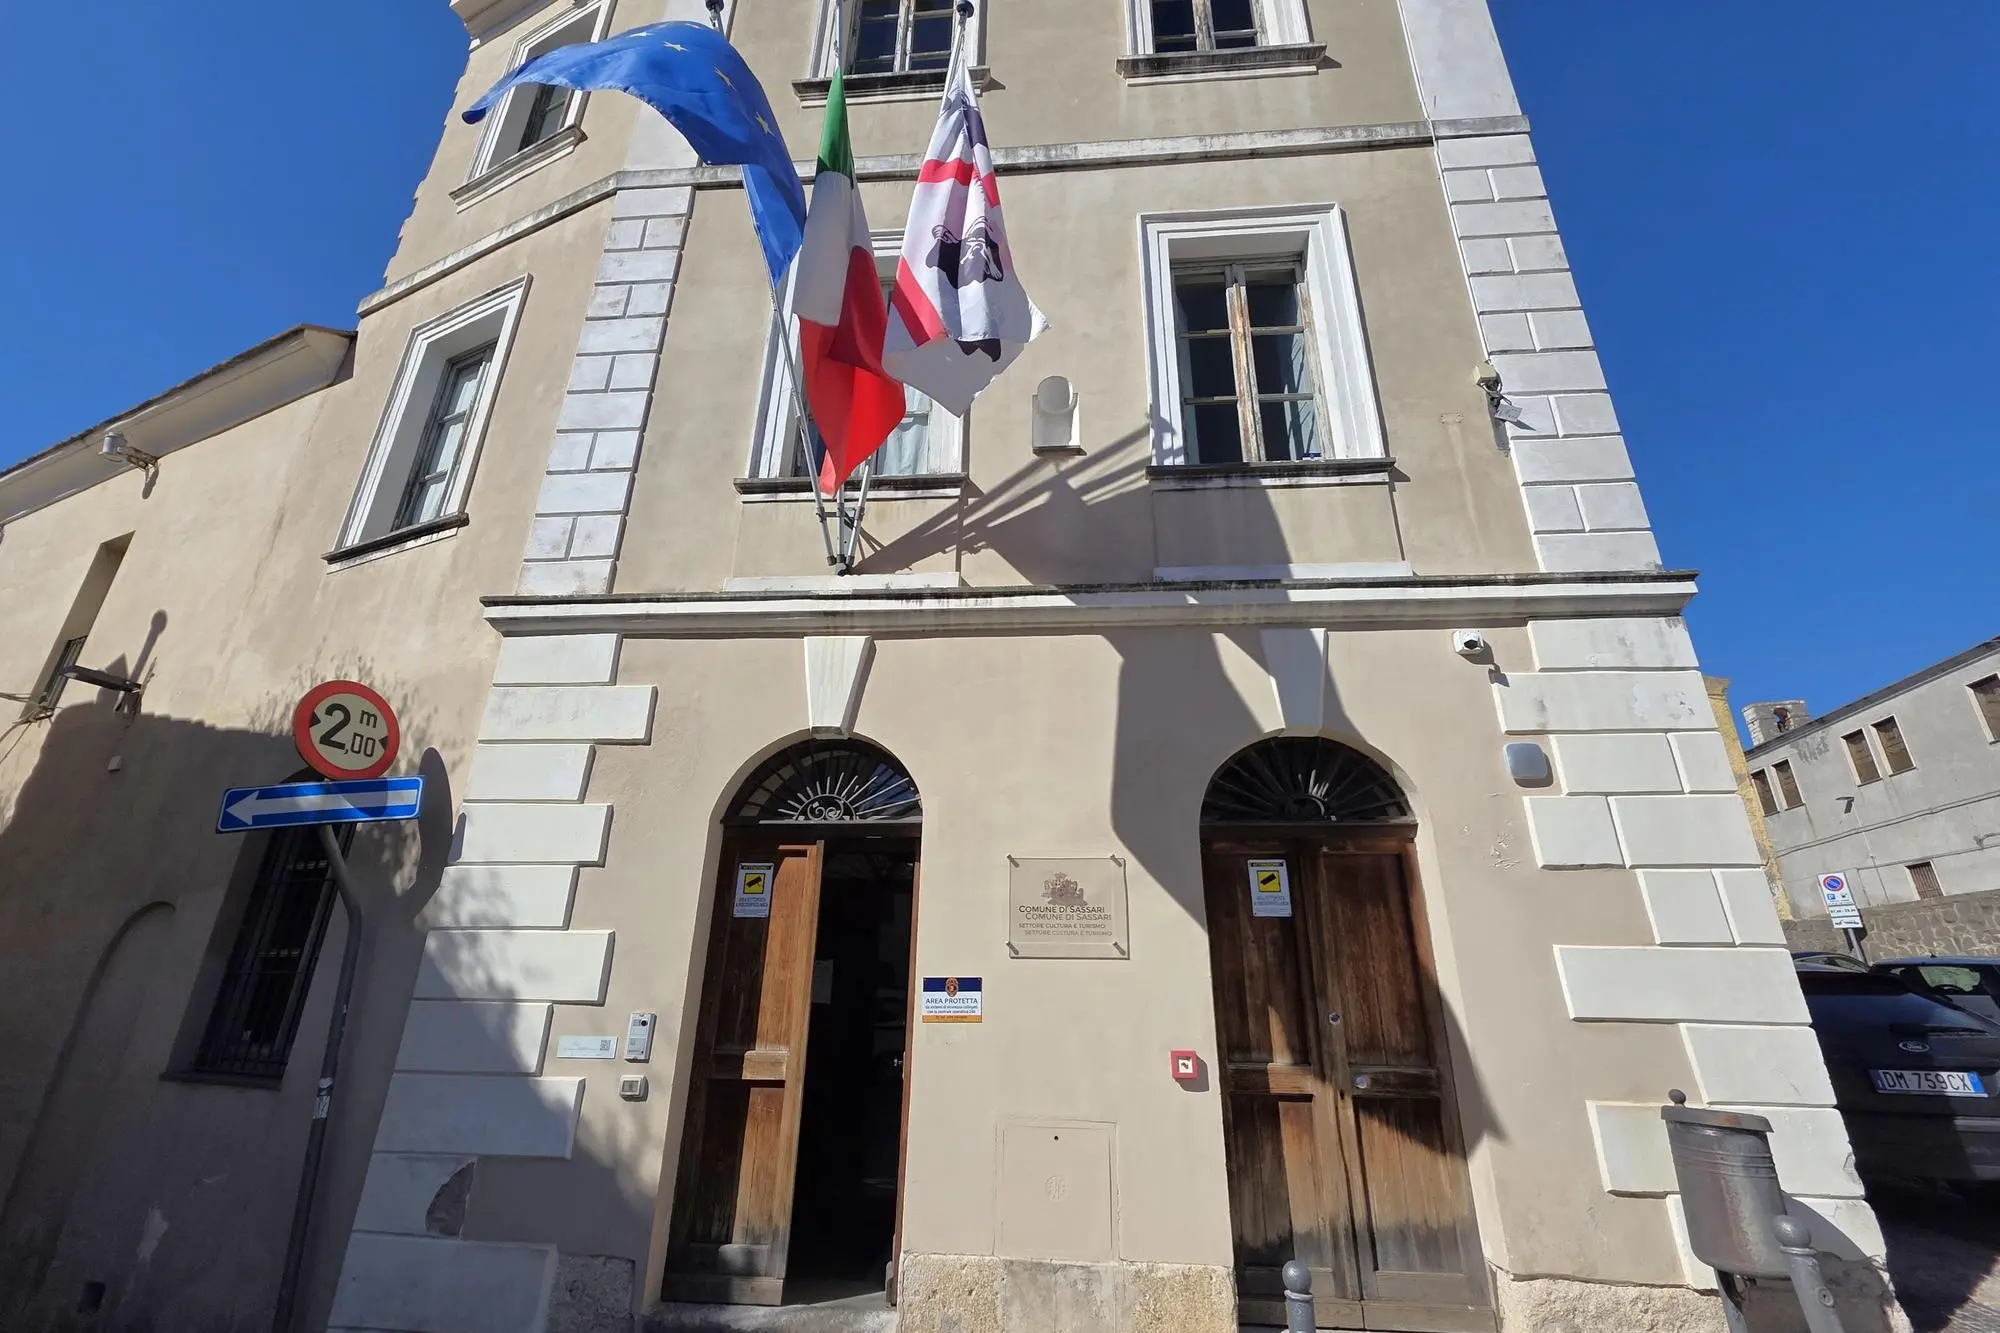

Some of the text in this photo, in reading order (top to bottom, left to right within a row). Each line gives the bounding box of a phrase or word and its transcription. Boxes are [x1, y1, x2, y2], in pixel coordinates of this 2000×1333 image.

[1018, 905, 1057, 913] COMUNE
[1069, 905, 1105, 913] SASSARI
[1882, 1072, 1910, 1089] DM
[1911, 1073, 1972, 1091] 759CX
